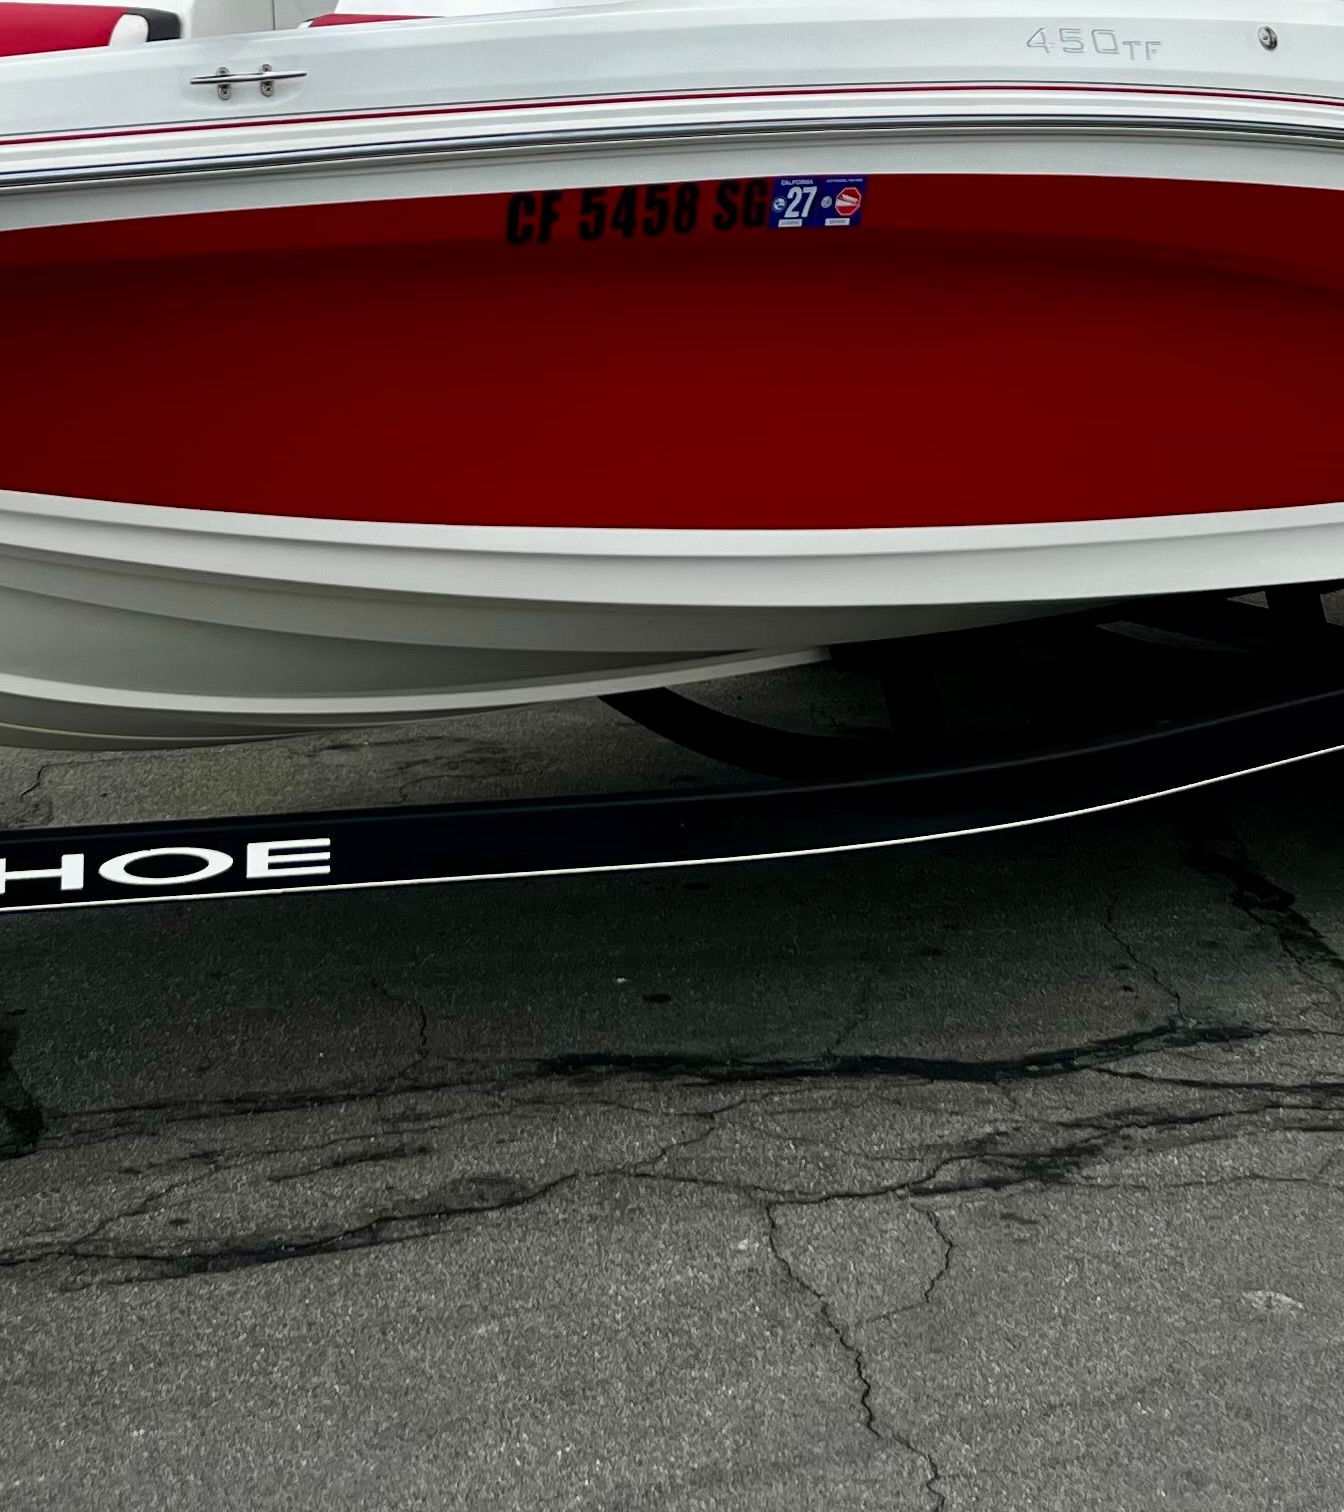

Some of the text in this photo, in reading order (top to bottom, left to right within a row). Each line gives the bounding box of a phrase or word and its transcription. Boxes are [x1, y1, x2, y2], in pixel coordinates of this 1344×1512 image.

[507, 178, 768, 245] CF 5458 SG
[784, 186, 817, 218] 27
